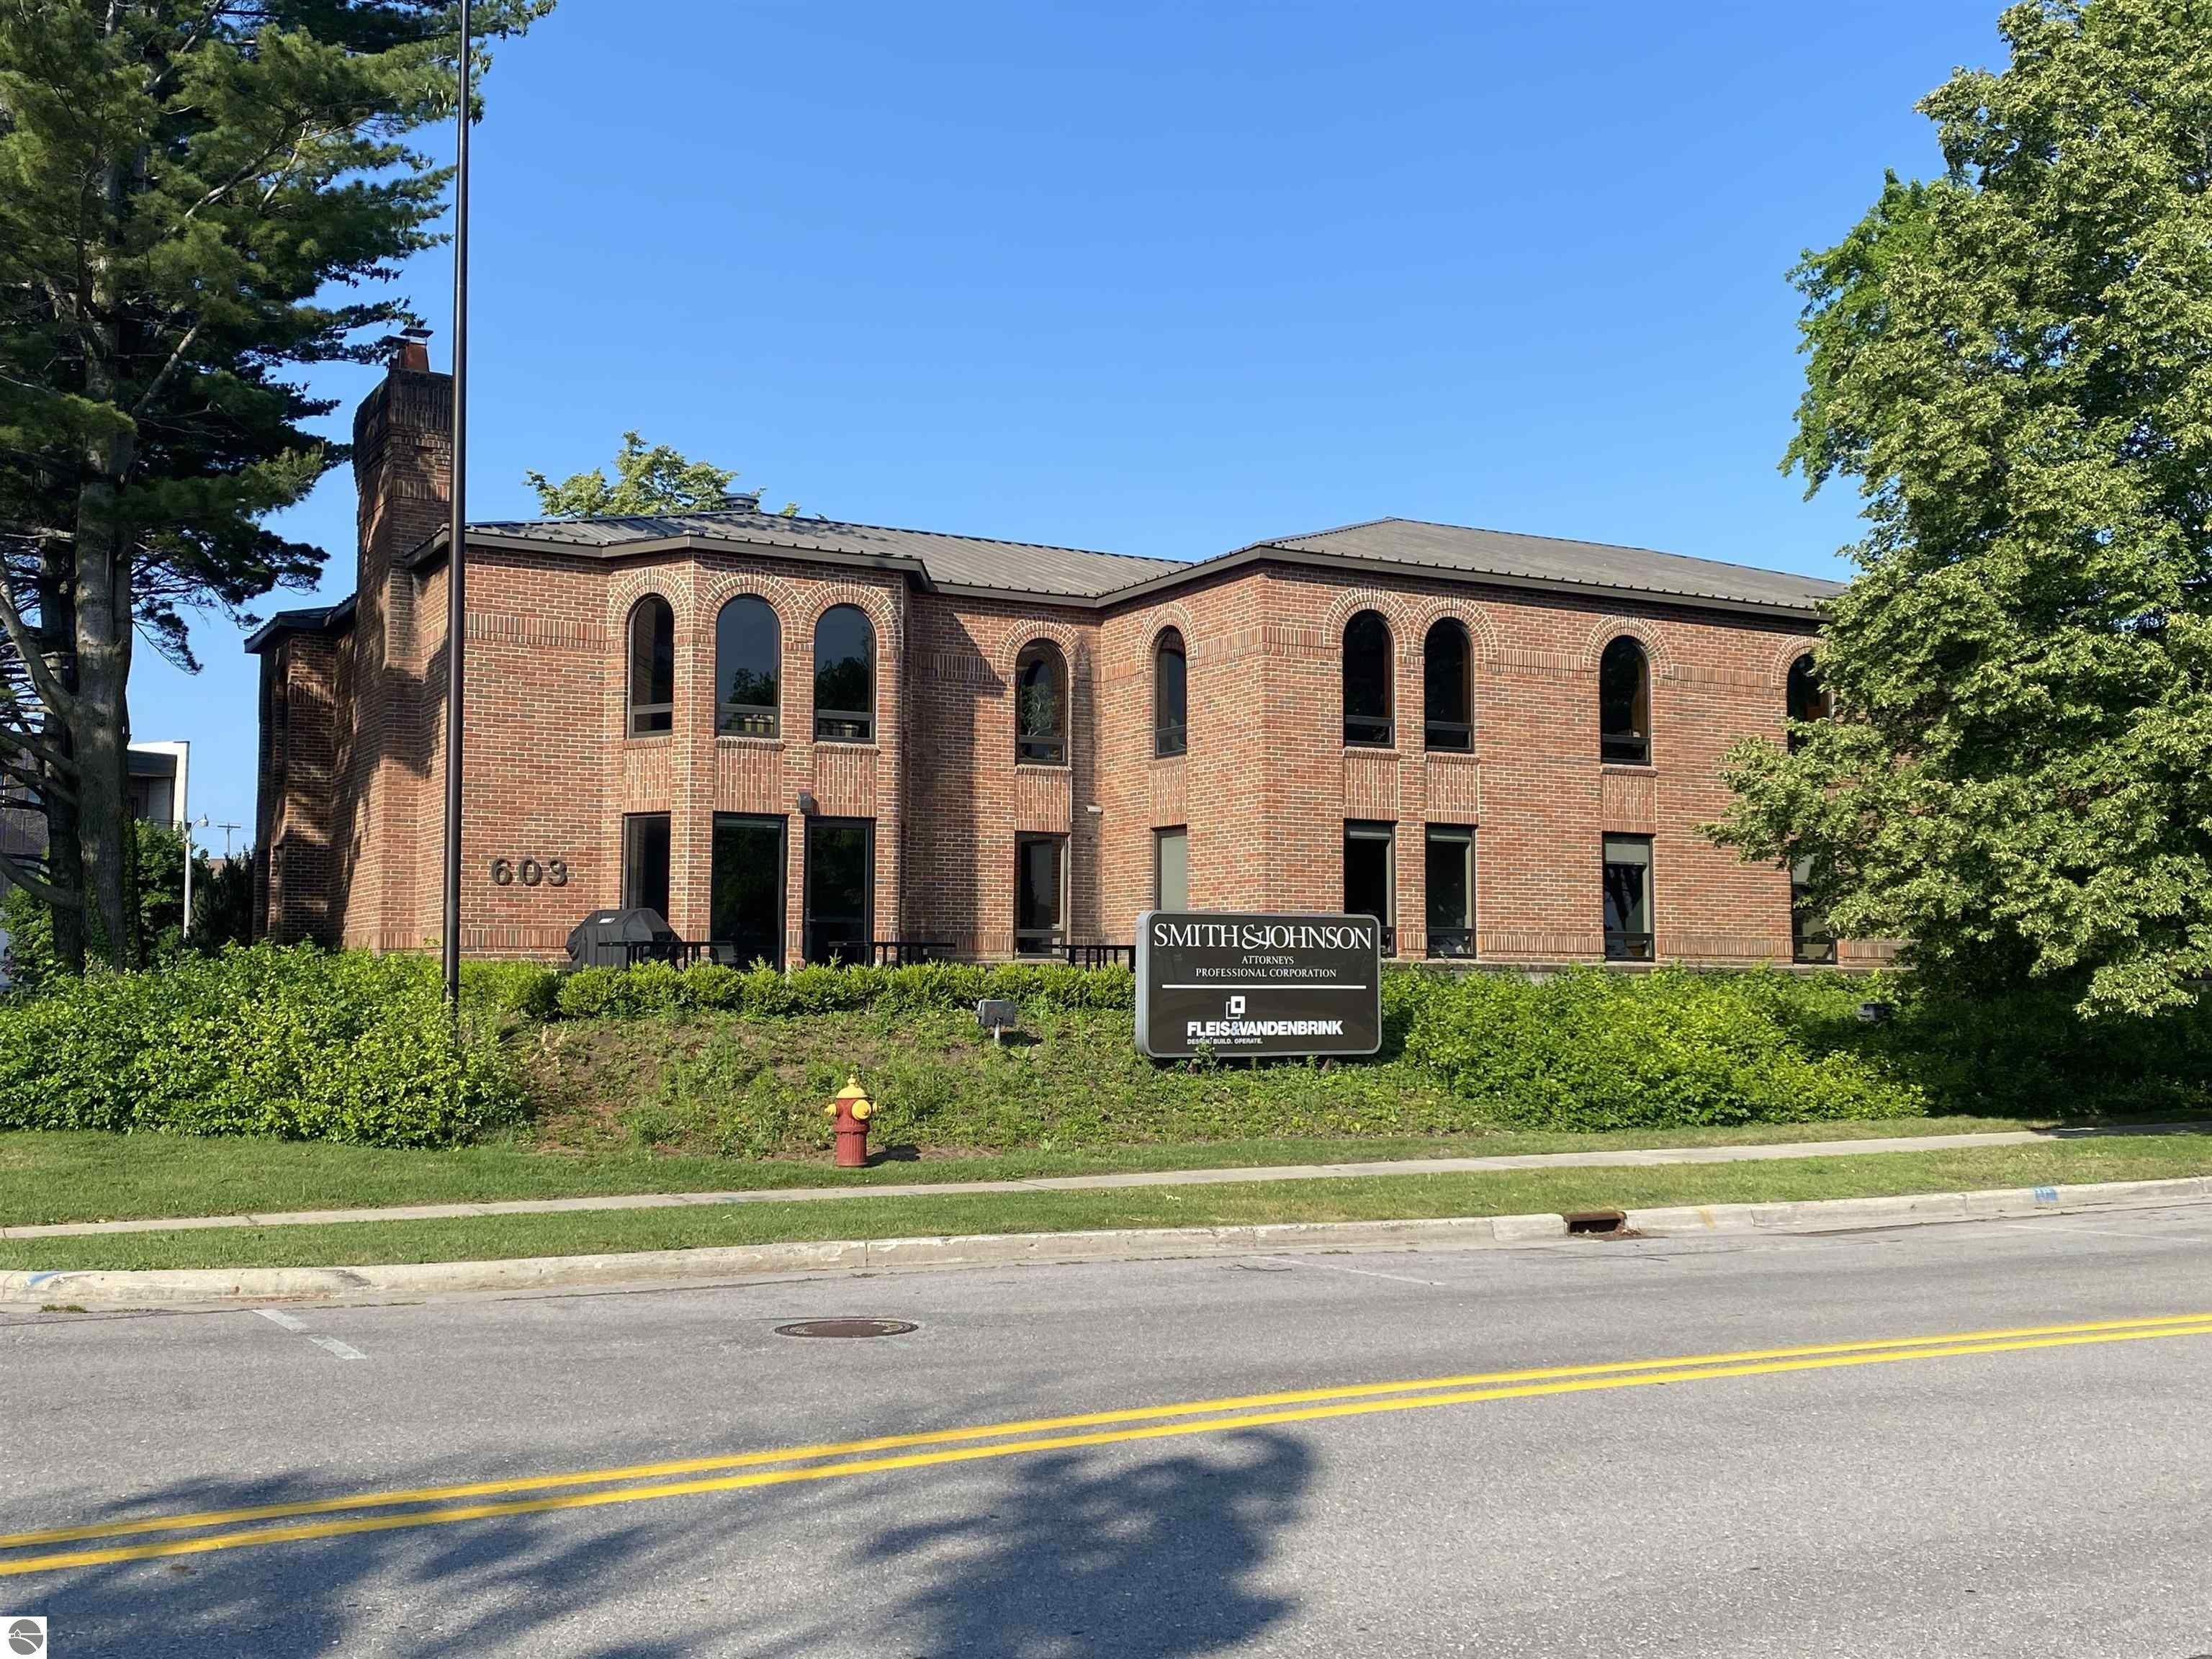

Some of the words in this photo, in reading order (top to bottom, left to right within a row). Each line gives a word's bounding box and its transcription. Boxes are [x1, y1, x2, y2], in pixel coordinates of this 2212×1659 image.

[491, 856, 567, 886] 603
[1241, 956, 1295, 965] ATTORNEYS
[1195, 967, 1267, 978] PROFESSIONAL
[1269, 968, 1337, 978] CORPORATION
[1187, 1020, 1343, 1036] FLEIS&VANDENBRINK
